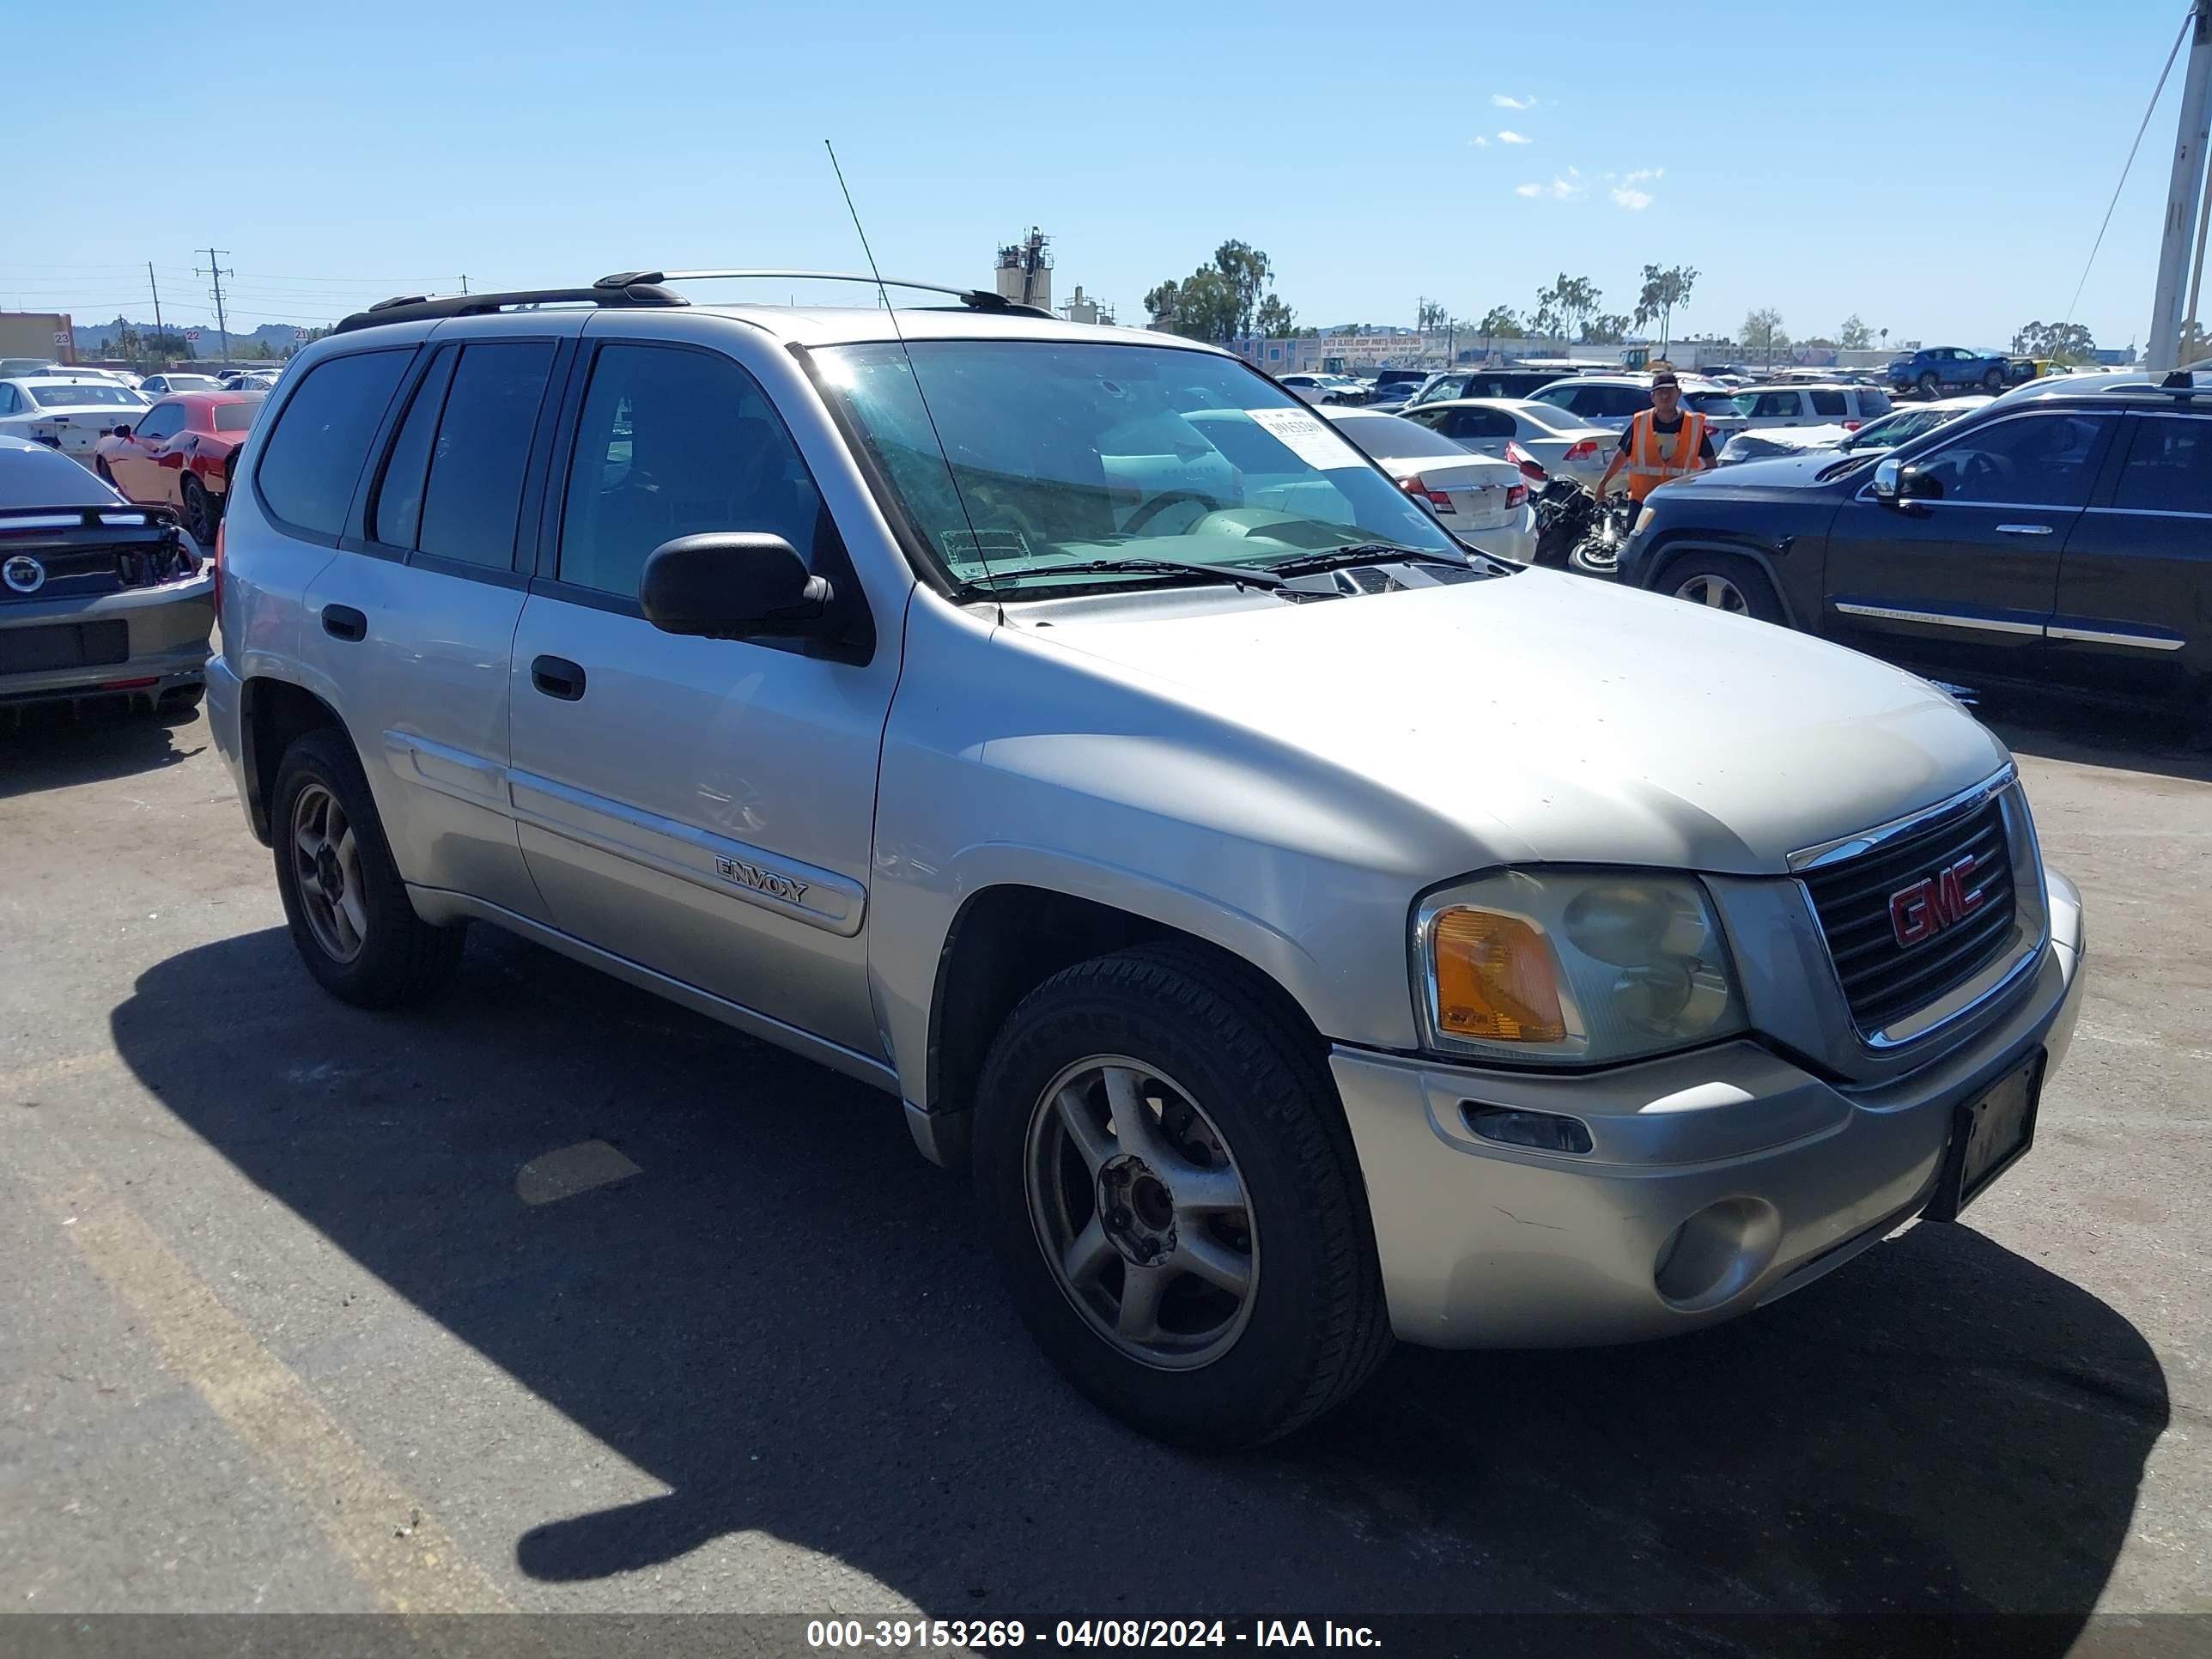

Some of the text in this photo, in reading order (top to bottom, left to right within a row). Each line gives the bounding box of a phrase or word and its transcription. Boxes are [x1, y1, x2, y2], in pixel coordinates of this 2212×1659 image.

[55, 334, 69, 343] 23
[186, 331, 199, 340] 22
[715, 855, 809, 902] ENVOY
[1889, 854, 1984, 949] GMC
